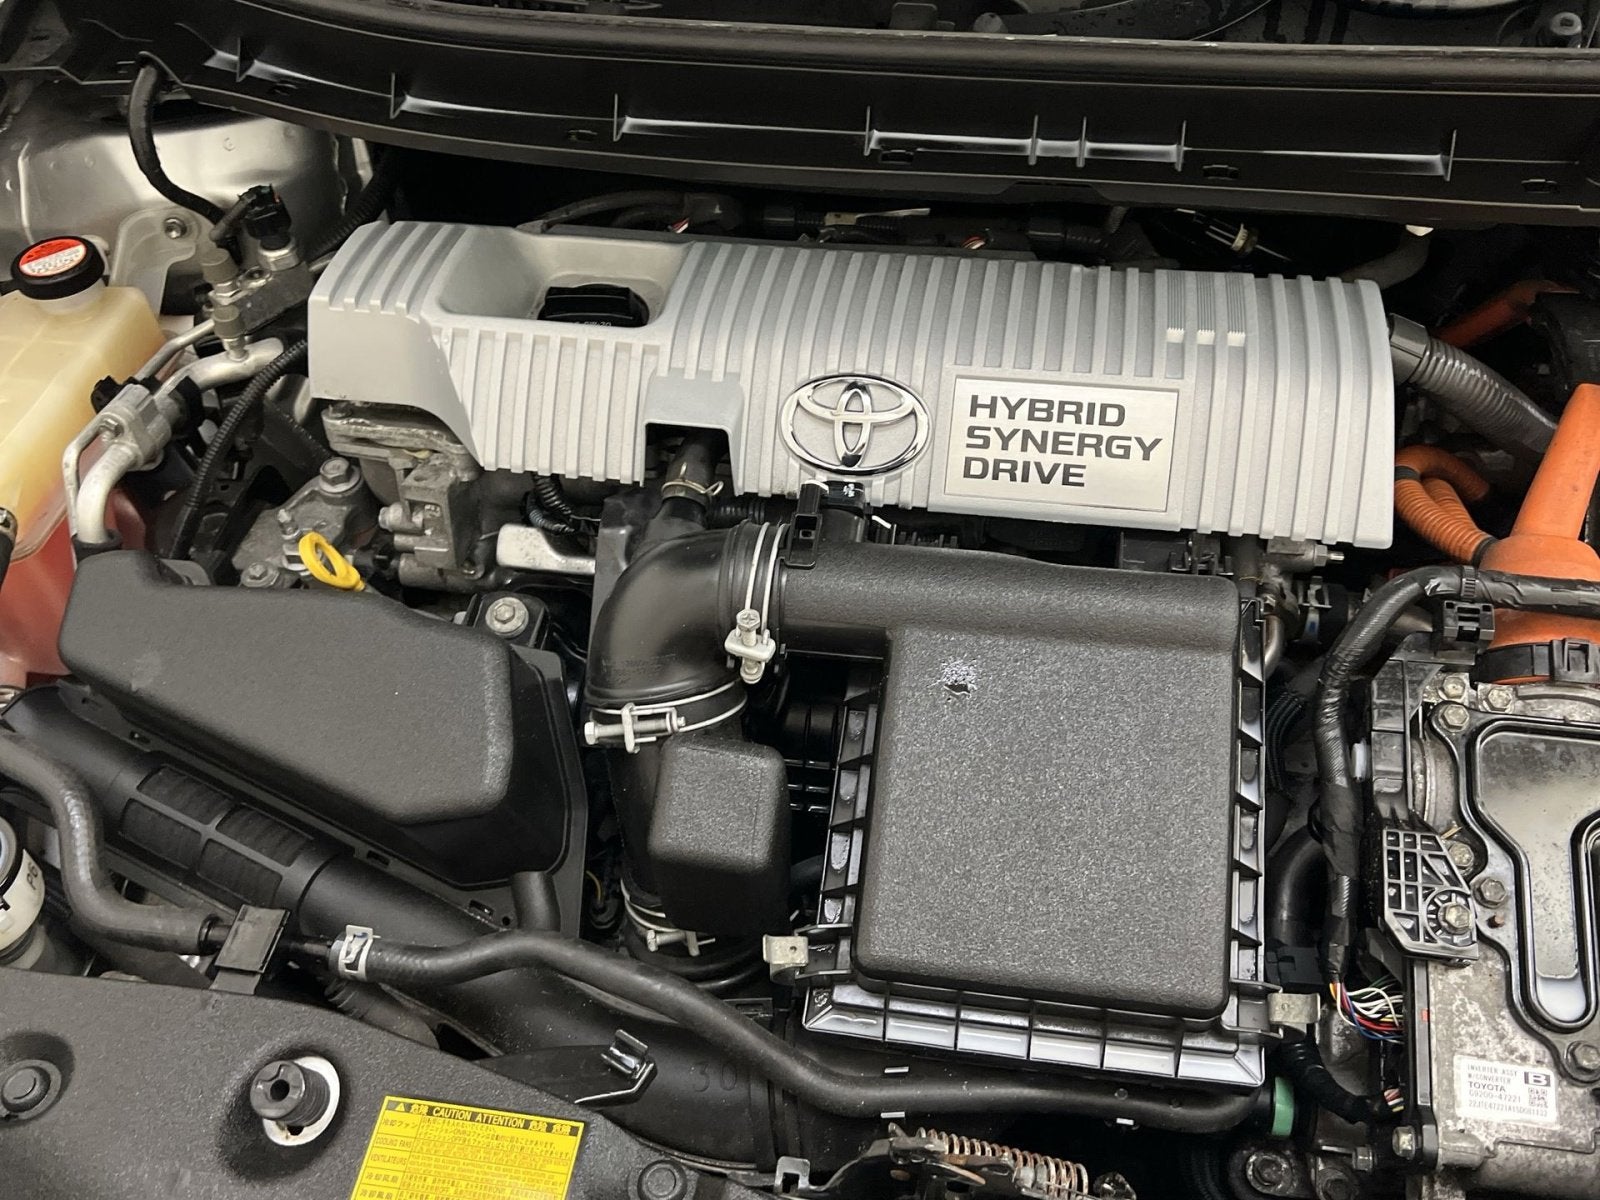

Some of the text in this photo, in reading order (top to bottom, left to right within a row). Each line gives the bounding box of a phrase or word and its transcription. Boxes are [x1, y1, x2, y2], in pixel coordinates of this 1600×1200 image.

[969, 394, 1126, 427] HYBRID
[966, 425, 1163, 461] SYNERGY
[963, 456, 1087, 487] DRIVE
[1468, 1081, 1506, 1092] TOYOTA
[432, 1106, 472, 1121] CAUTION
[474, 1113, 526, 1129] ATTENTION
